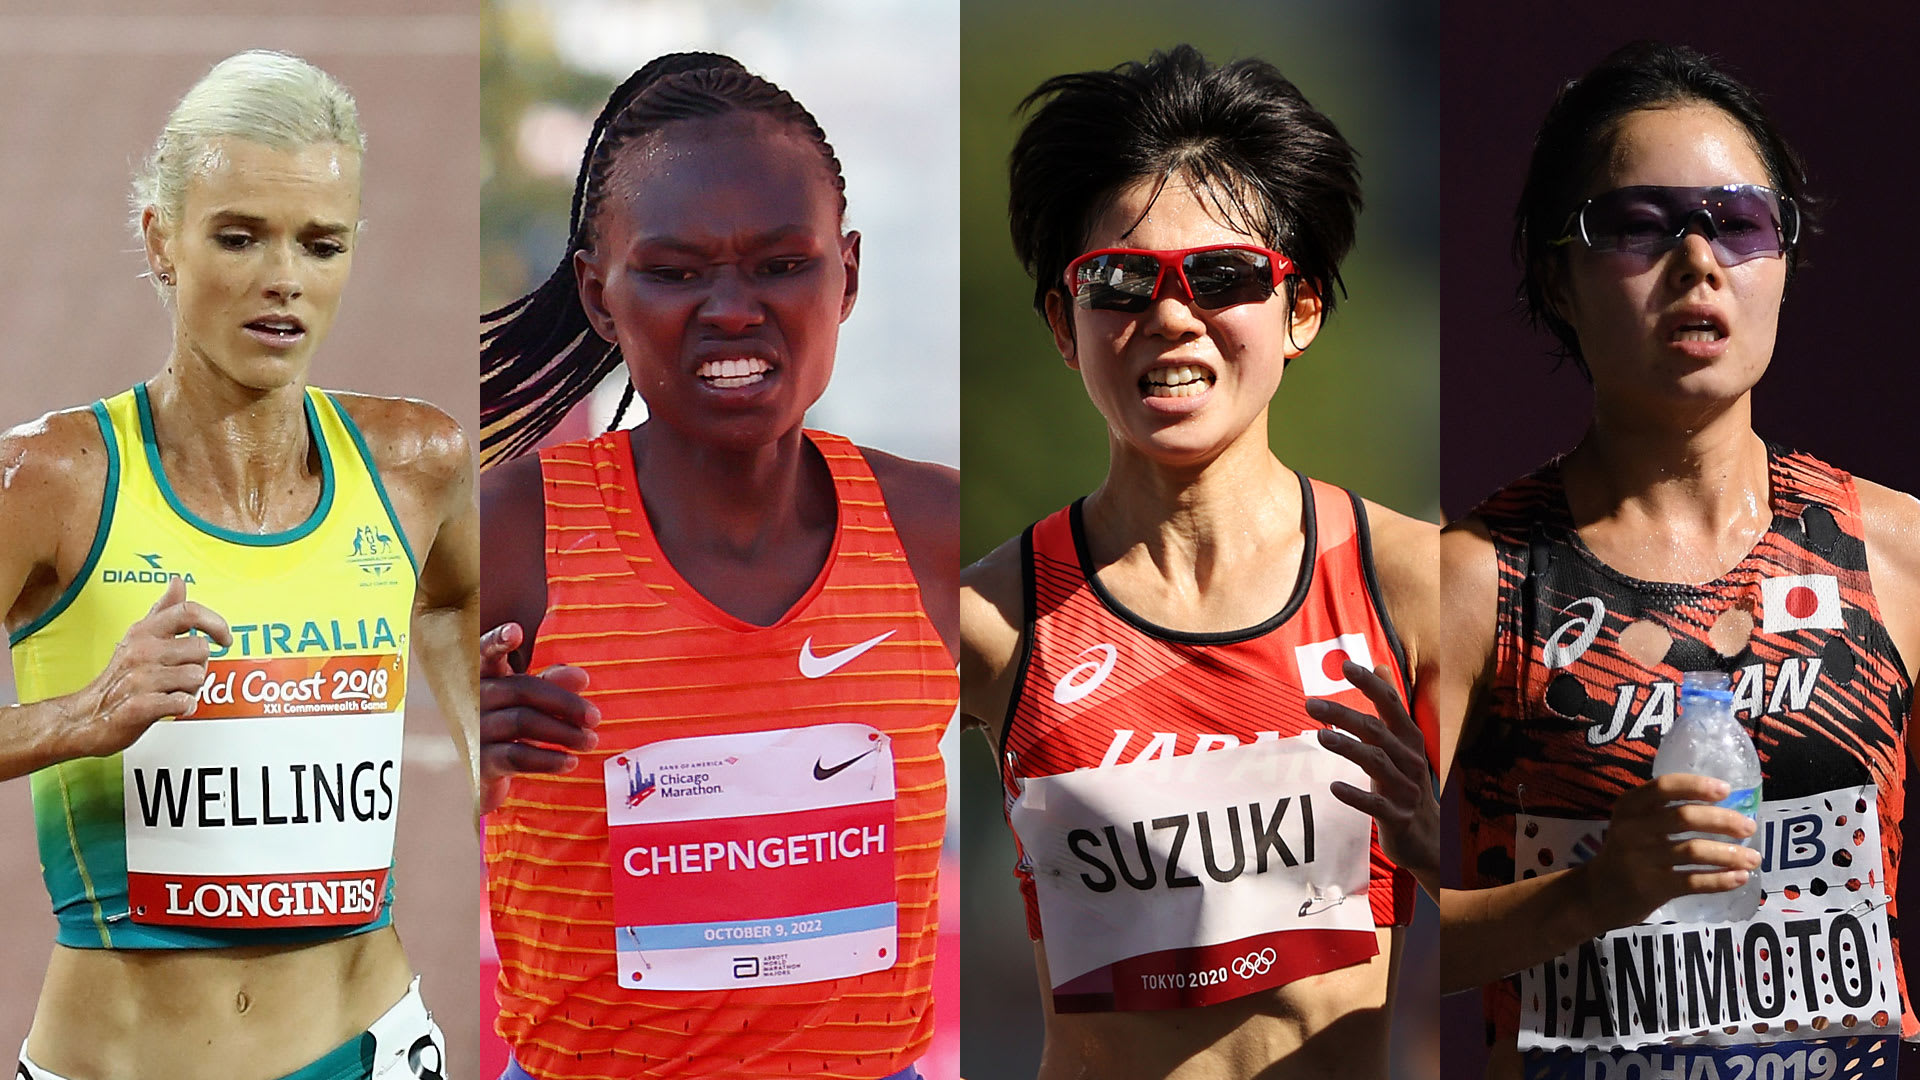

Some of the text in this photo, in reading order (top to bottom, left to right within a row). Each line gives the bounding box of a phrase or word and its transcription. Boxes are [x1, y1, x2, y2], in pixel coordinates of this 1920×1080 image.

[189, 617, 396, 657] TRALIA
[196, 668, 388, 704] ld Coast 2018
[1587, 657, 1823, 745] JAAN
[264, 704, 281, 714] XXI
[284, 702, 359, 714] Commonwealth
[133, 760, 393, 827] WELLINGS
[660, 773, 709, 785] Chicago
[624, 824, 885, 877] CHEPNGETICH
[1066, 794, 1315, 893] SUZUKI
[165, 878, 376, 918] LONGINES
[704, 919, 822, 940] OCTOBER 9, 2022
[1141, 967, 1228, 990] TOKYO 2020
